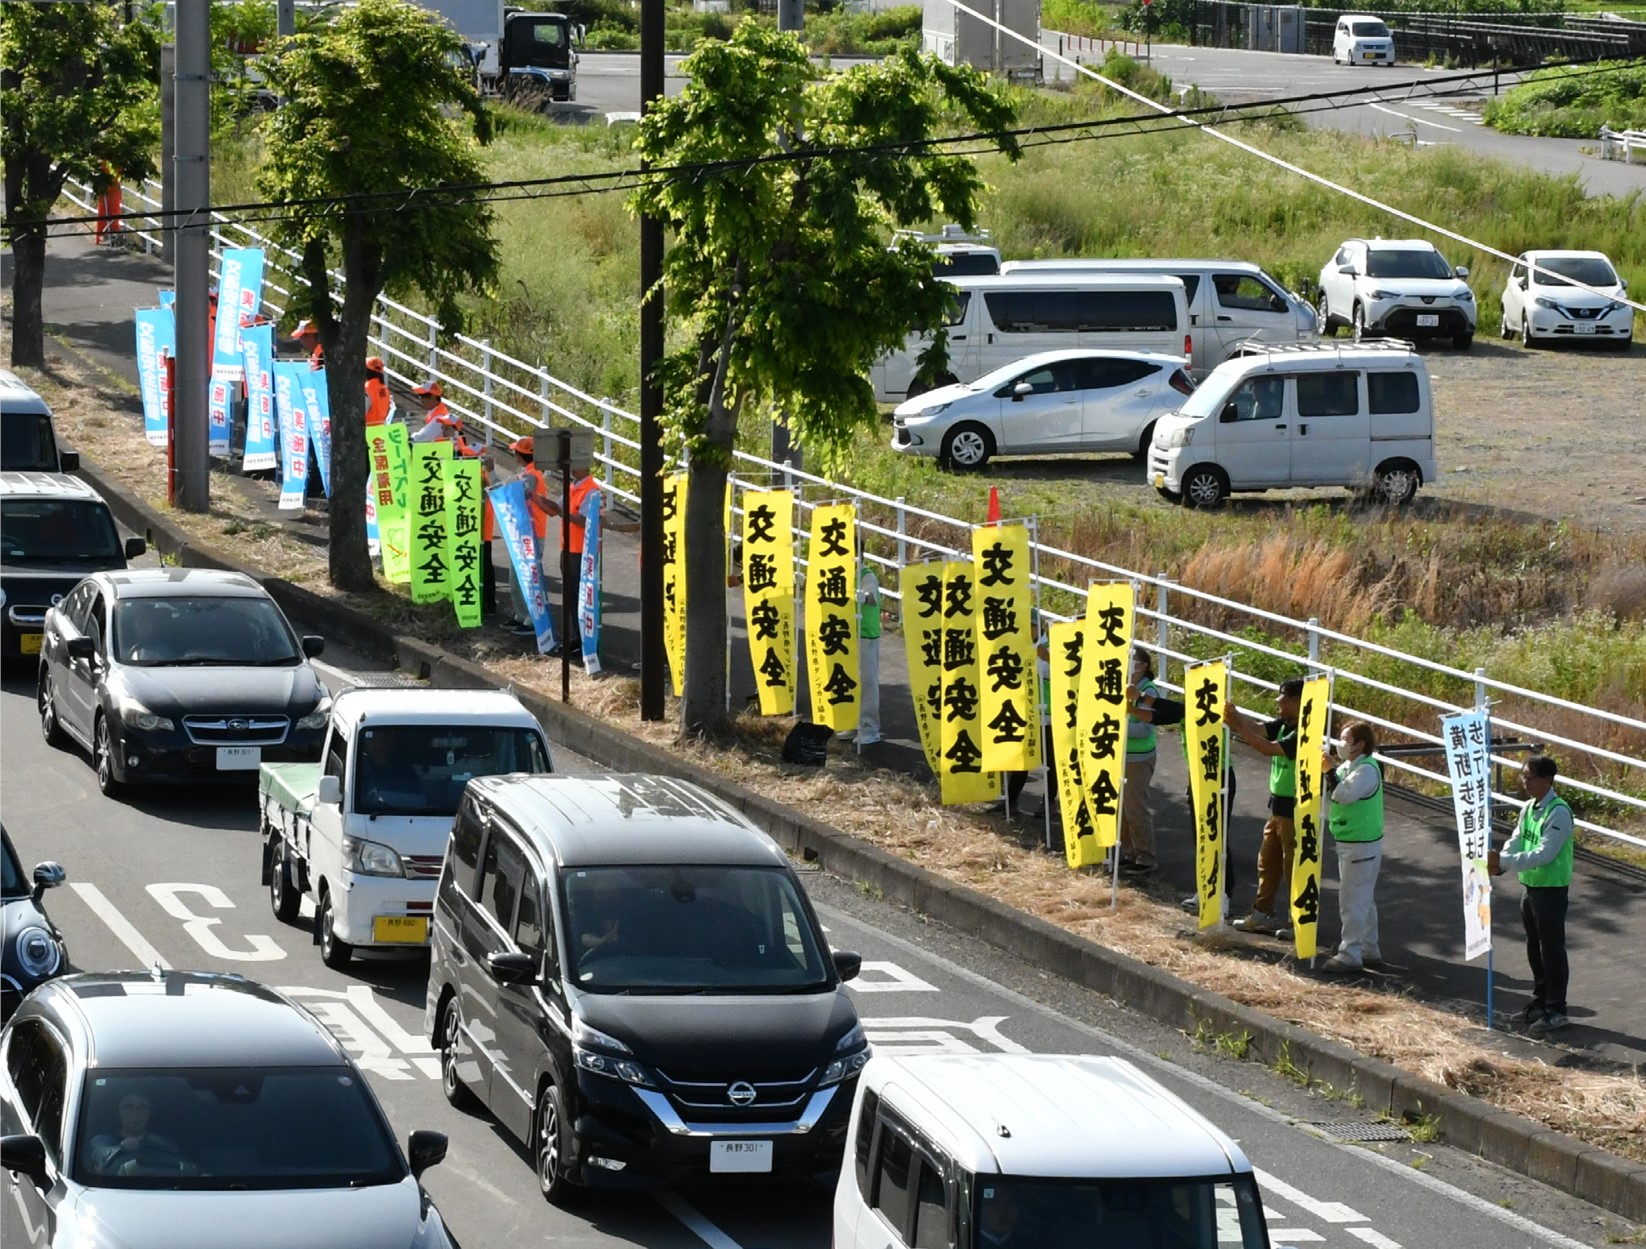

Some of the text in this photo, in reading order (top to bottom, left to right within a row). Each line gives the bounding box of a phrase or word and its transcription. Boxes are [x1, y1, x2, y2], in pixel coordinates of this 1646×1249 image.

[818, 517, 857, 705] 交通安全
[1089, 601, 1126, 815] 交通安全
[726, 1143, 758, 1153] 長野301
